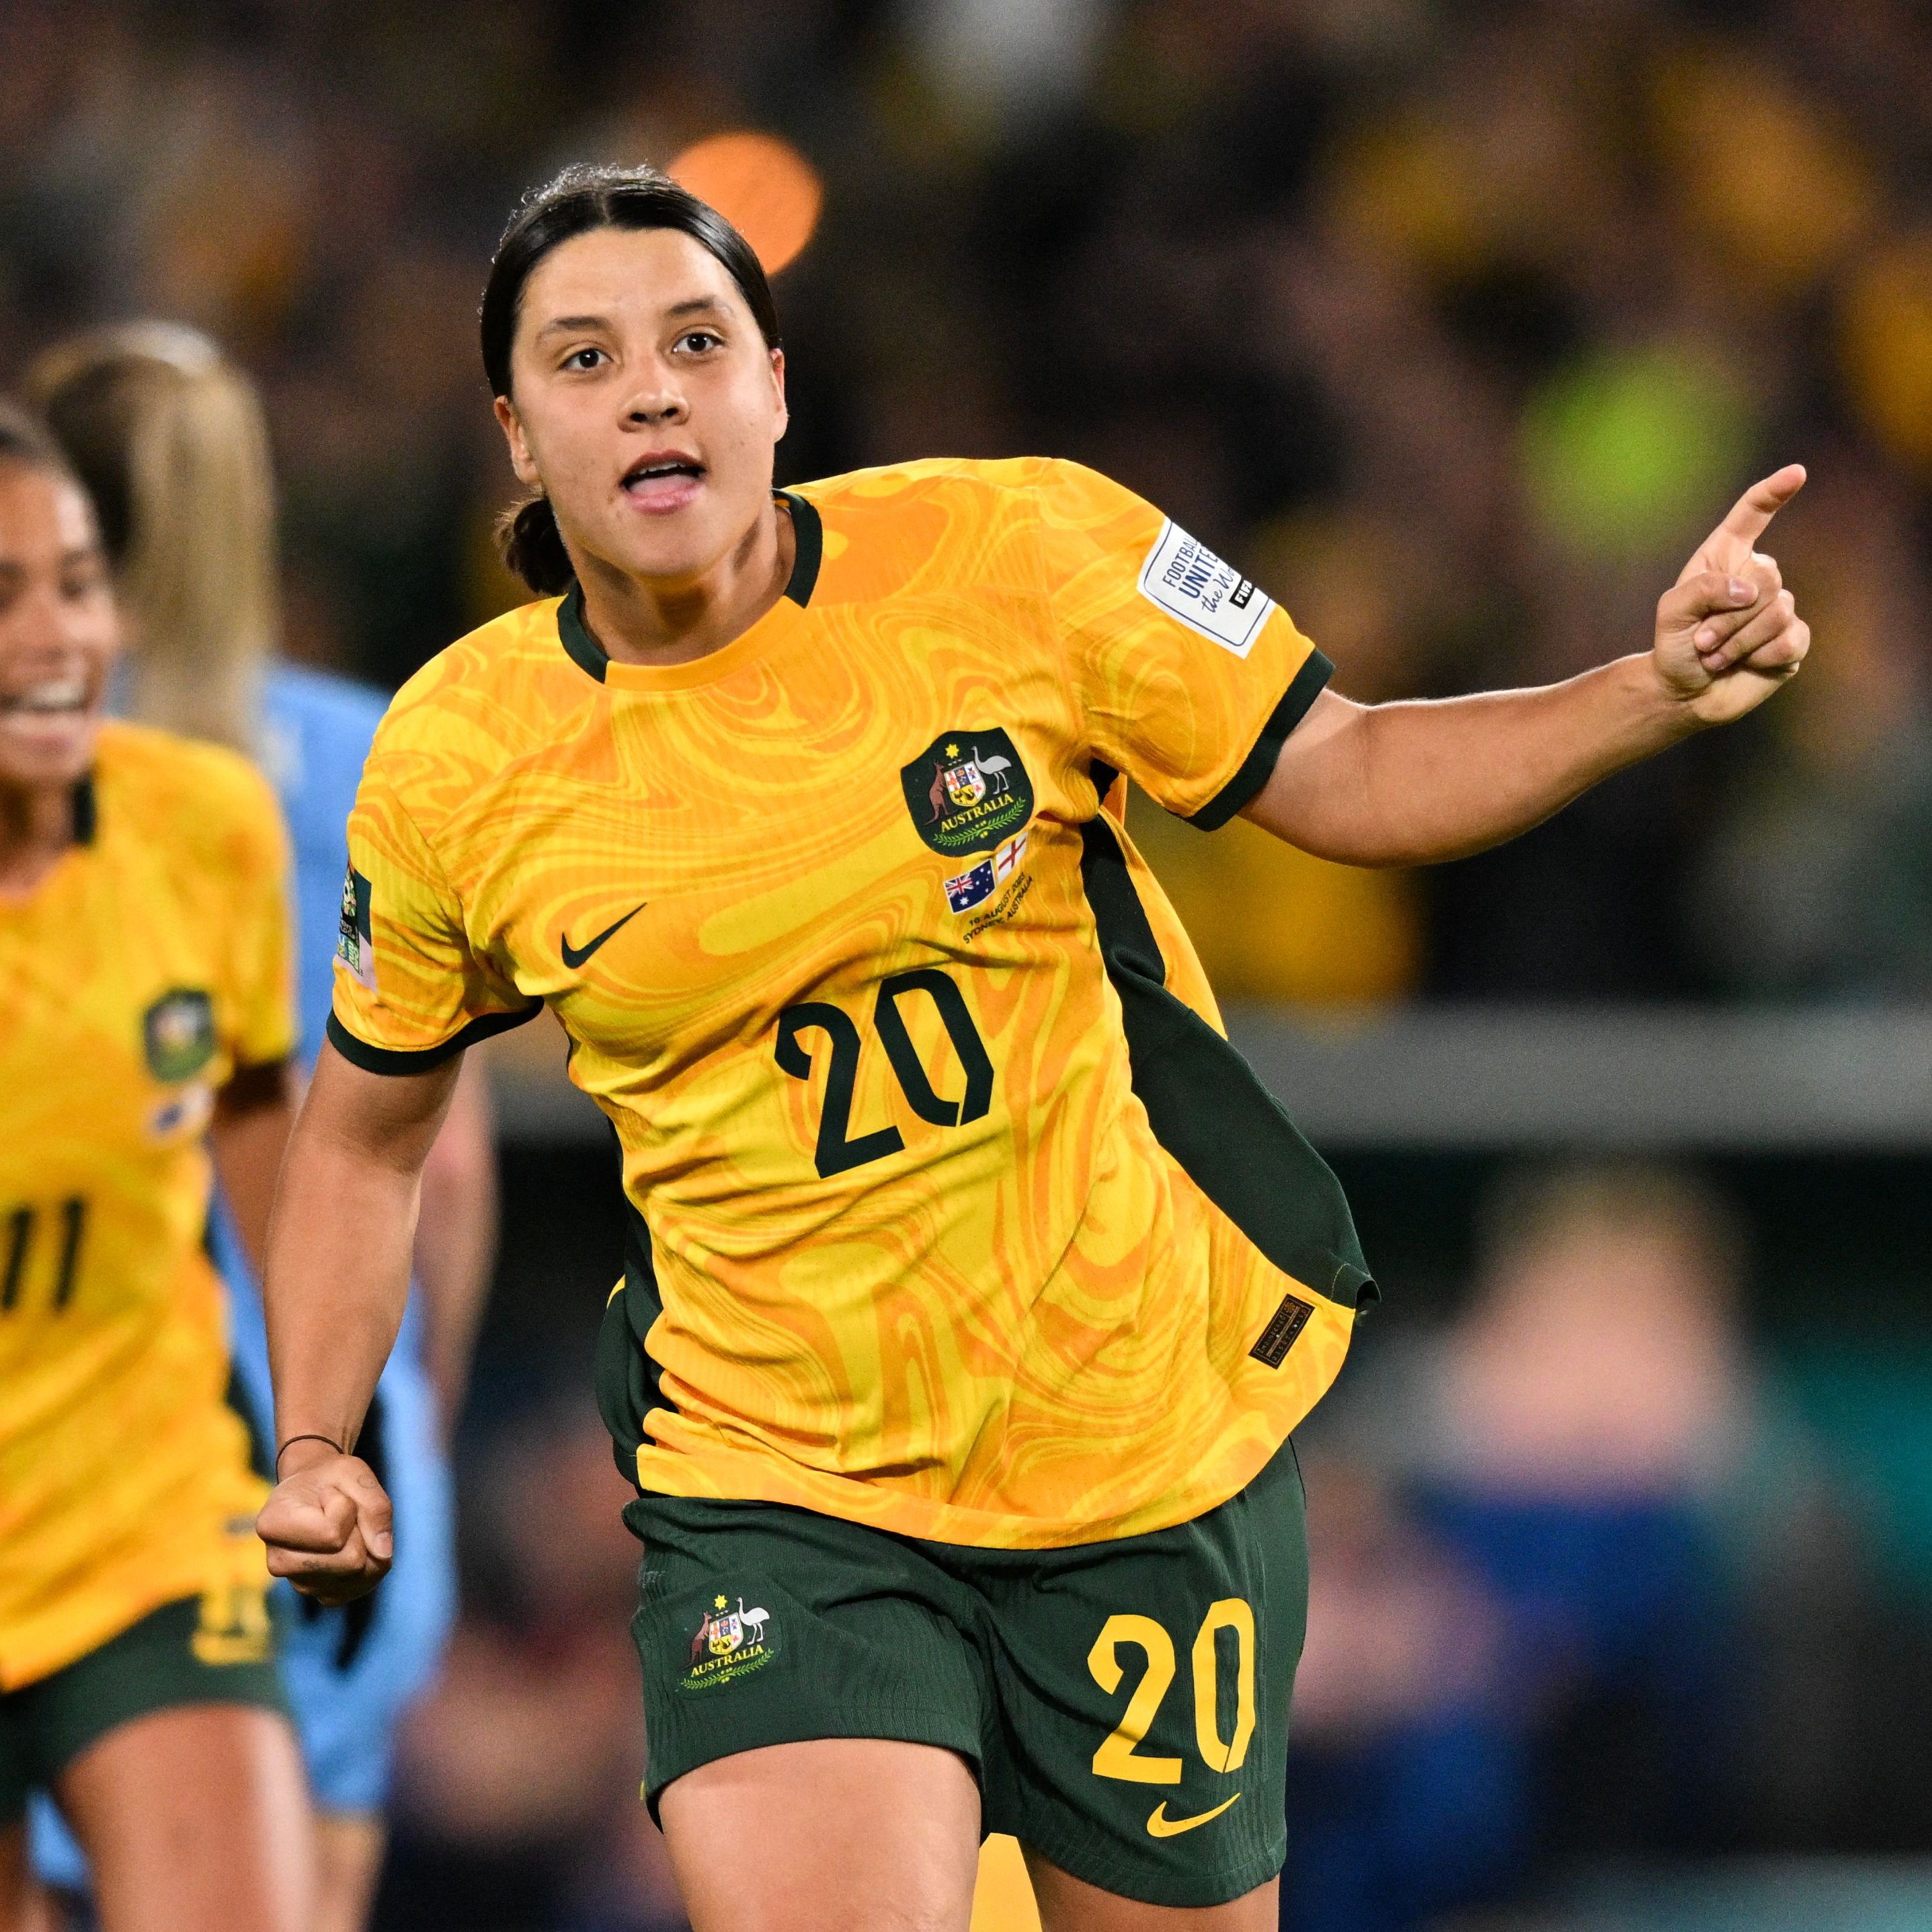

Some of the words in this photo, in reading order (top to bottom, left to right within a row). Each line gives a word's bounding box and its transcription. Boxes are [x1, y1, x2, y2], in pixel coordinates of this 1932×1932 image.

[1178, 545, 1218, 599] UNITE
[1201, 590, 1223, 612] the
[941, 793, 1014, 833] AUSTRALIA
[984, 889, 1012, 921] AUGUST
[774, 969, 994, 1179] 20
[1, 1195, 85, 1312] 11
[690, 1644, 764, 1677] AUSTRALIA
[1087, 1598, 1256, 1783] 20
